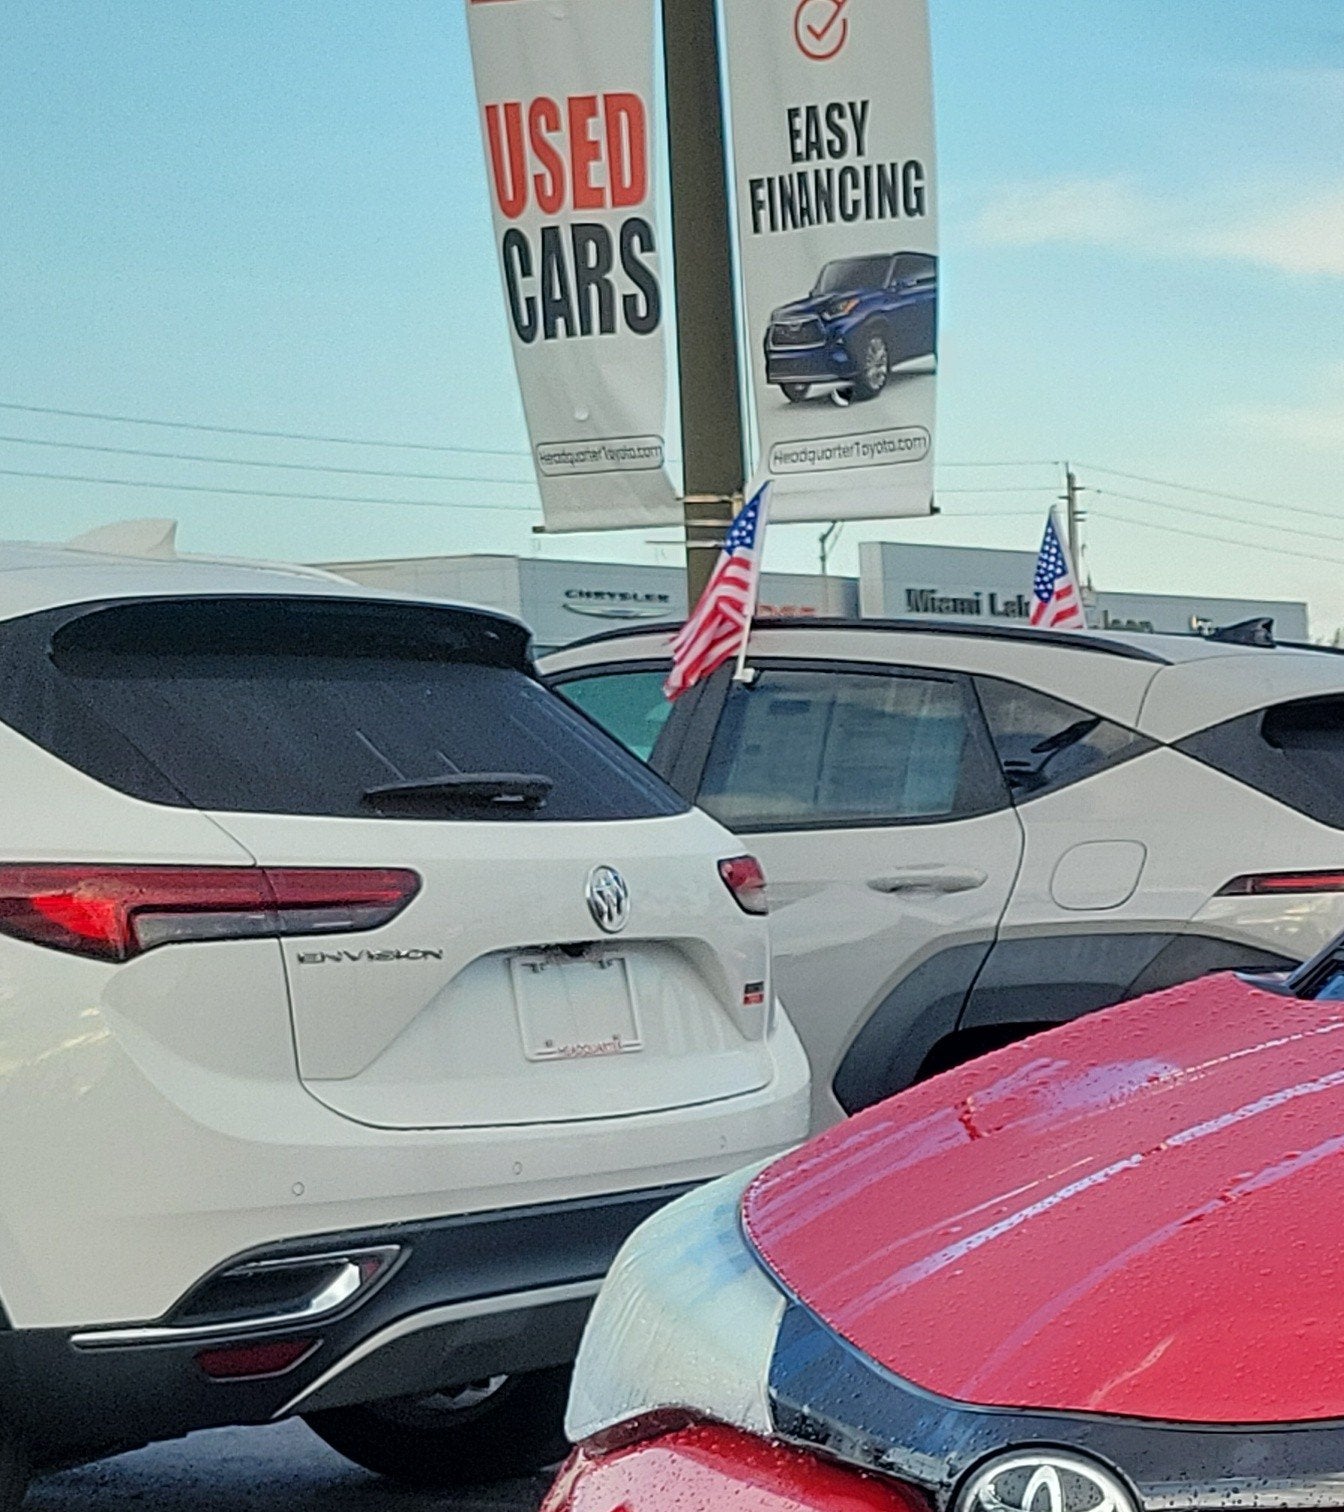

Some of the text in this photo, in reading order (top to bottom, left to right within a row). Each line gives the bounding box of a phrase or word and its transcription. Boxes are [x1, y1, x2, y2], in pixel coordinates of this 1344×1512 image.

[485, 92, 648, 219] USED
[787, 100, 870, 164] EASY
[749, 160, 926, 233] FINANCING
[503, 217, 662, 344] CARS
[564, 588, 670, 603] CHRYSLER
[905, 588, 981, 616] Miami
[298, 949, 443, 963] ENVISION
